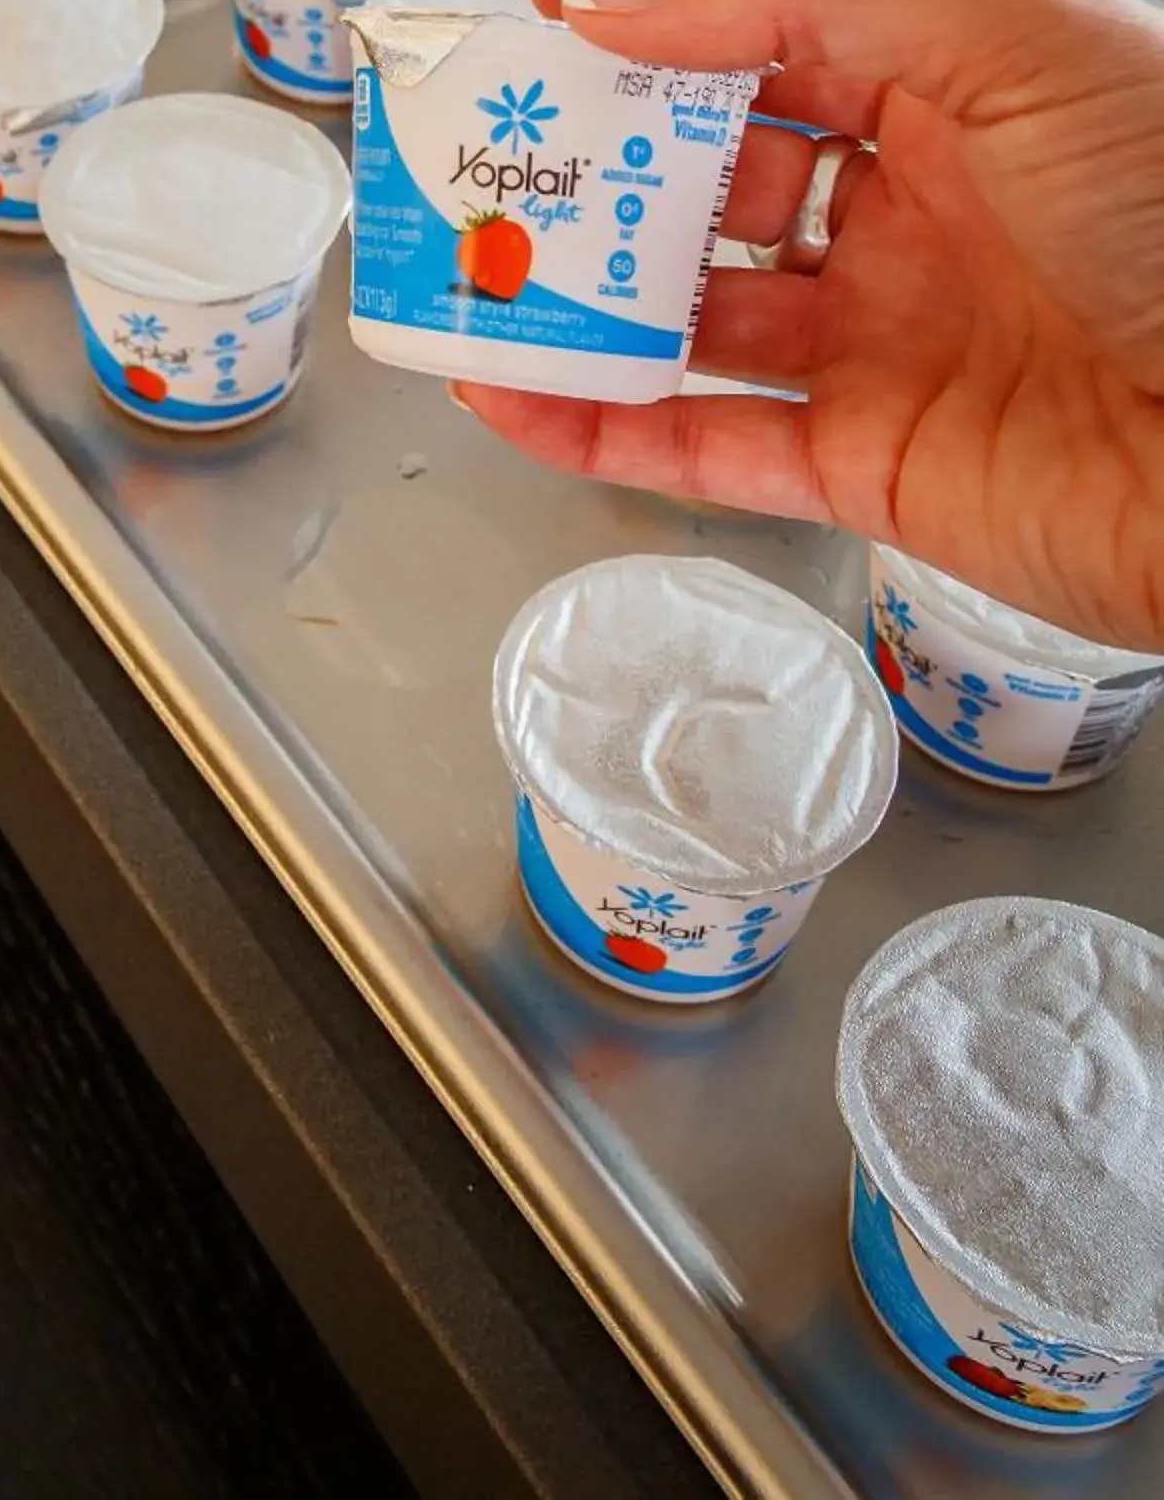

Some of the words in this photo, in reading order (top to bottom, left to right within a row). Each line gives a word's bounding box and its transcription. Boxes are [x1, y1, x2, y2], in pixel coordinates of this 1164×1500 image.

[614, 70, 653, 100] MSA
[449, 144, 583, 203] Yoplait
[517, 195, 584, 231] light
[612, 257, 632, 274] 50
[597, 897, 707, 940] Yoplait
[967, 1329, 1110, 1384] Yoplait
